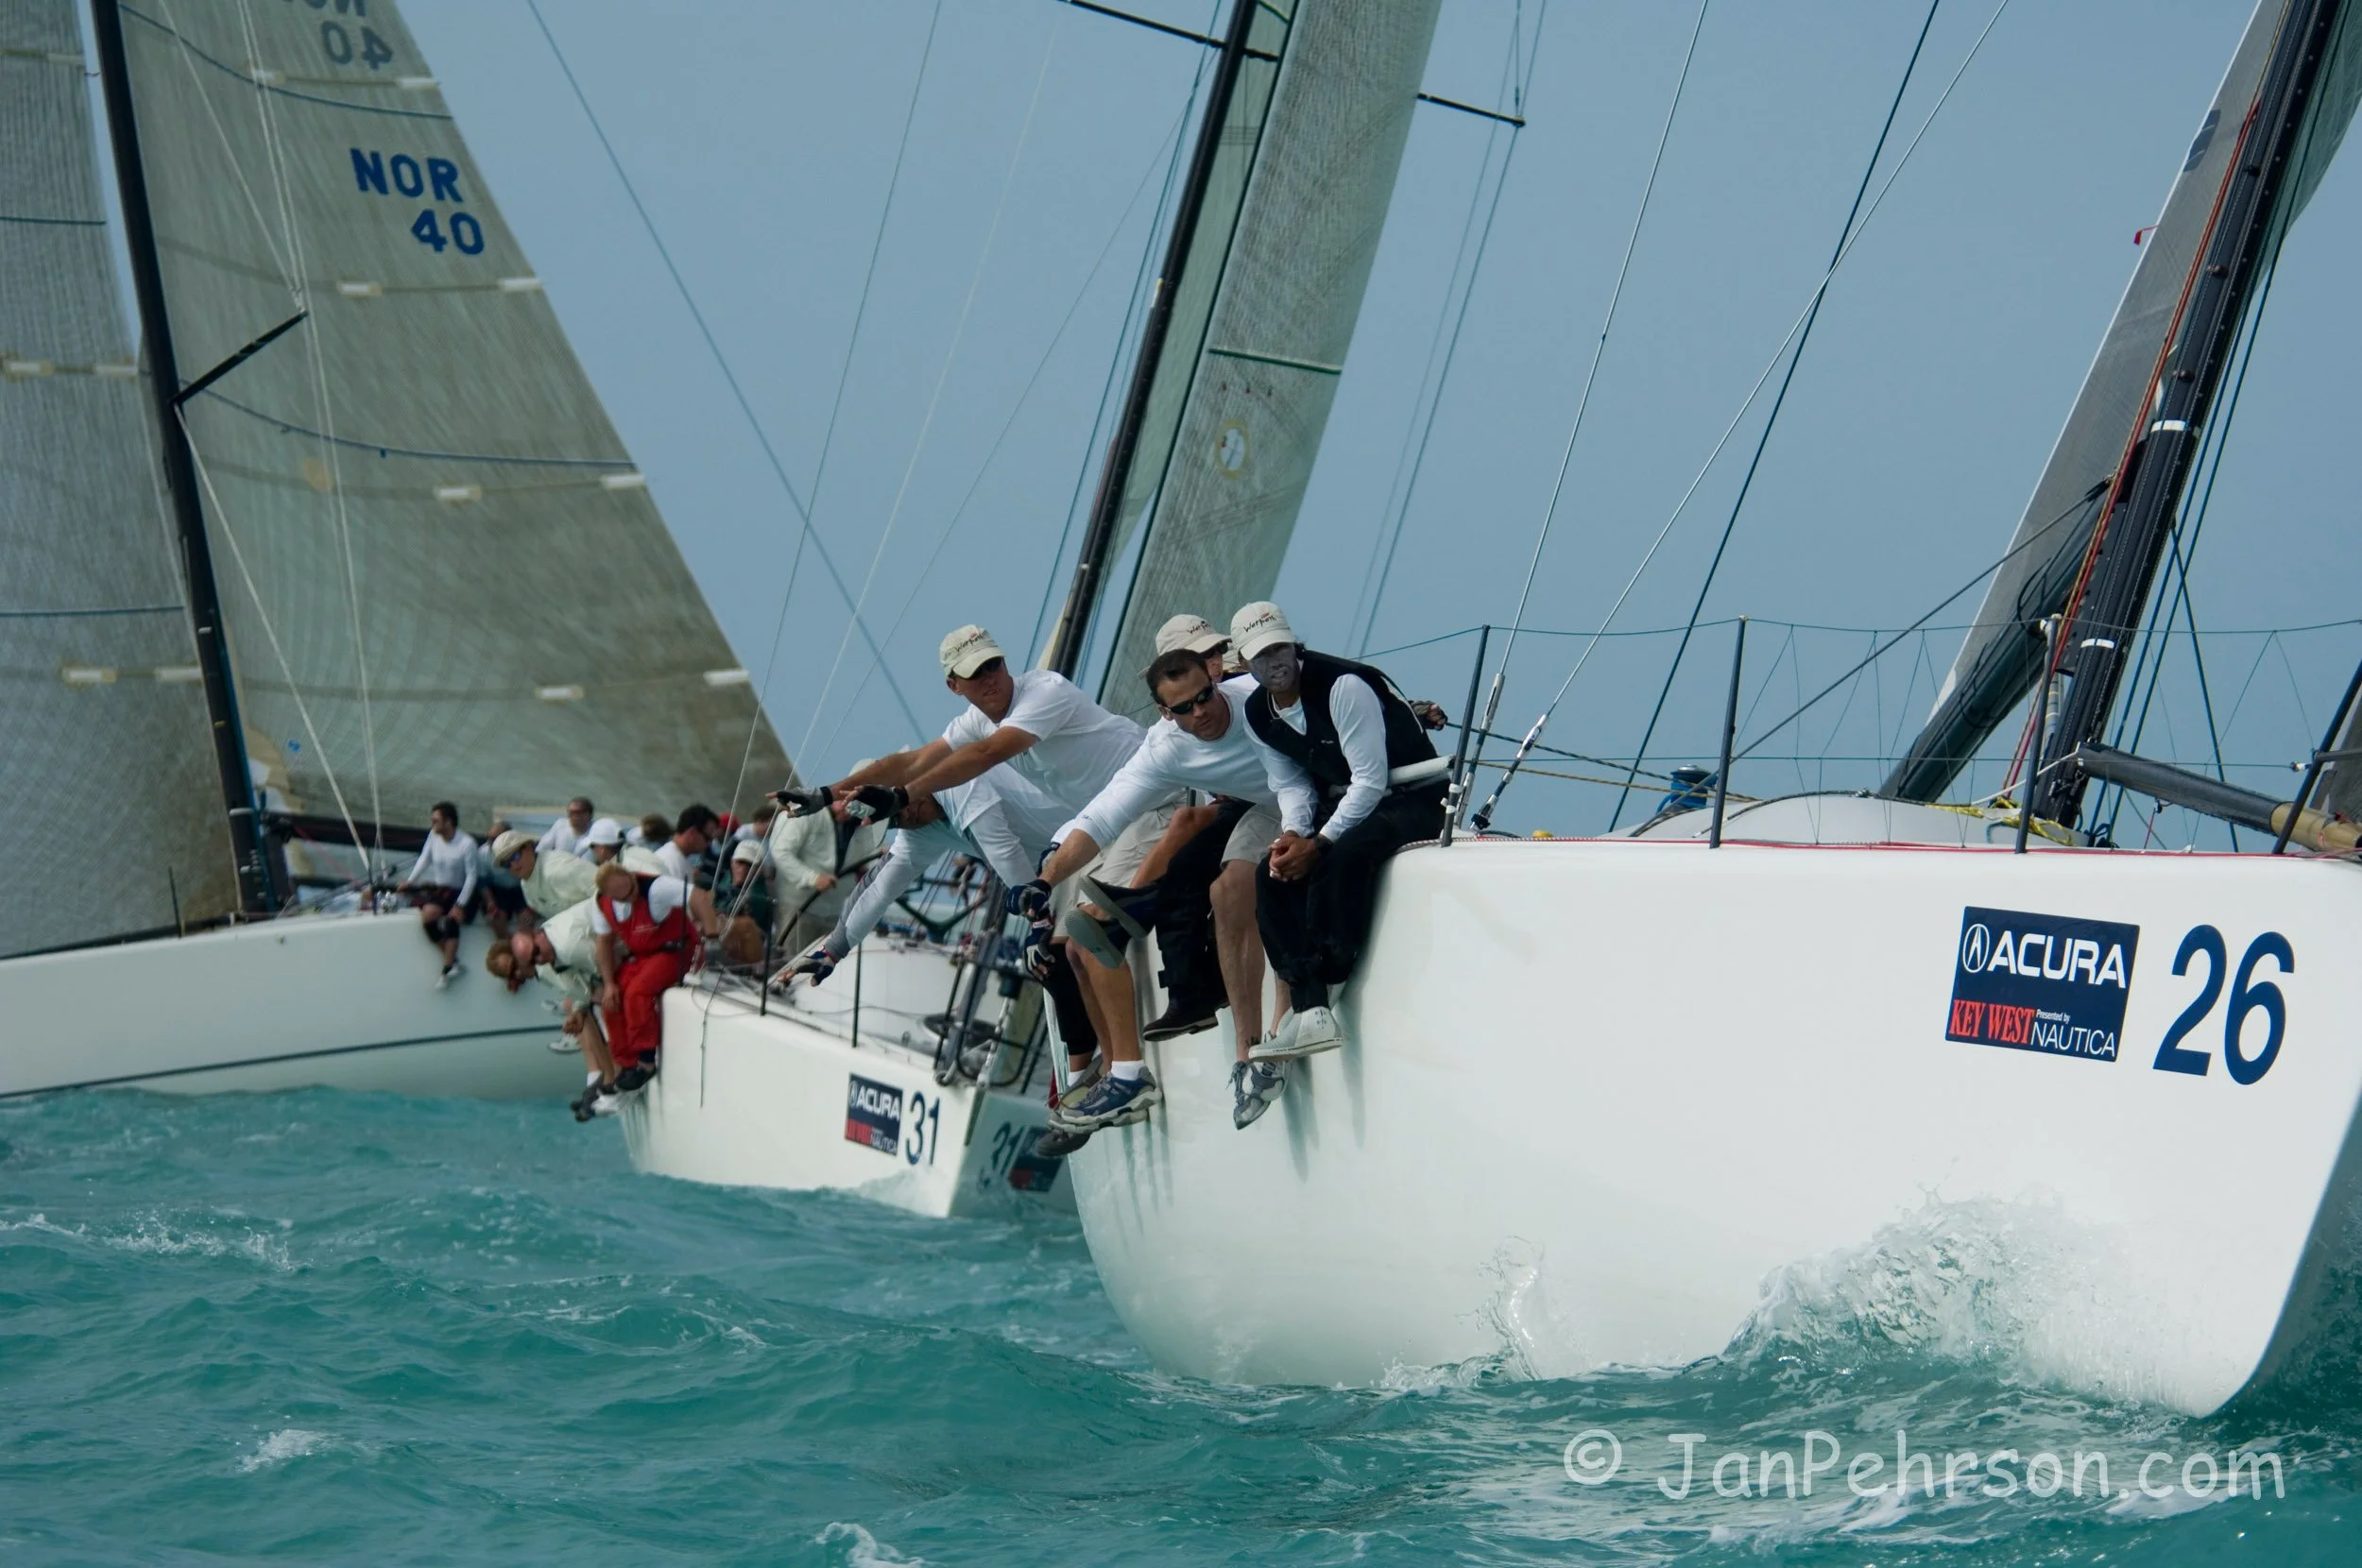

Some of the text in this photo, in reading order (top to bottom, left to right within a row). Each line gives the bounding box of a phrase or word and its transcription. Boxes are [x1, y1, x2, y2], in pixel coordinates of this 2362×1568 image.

[350, 147, 464, 203] NOR
[410, 209, 485, 256] 40
[1986, 930, 2126, 989] ACURA
[1949, 999, 2036, 1045] KEY WEST
[2035, 1009, 2071, 1025] Presented by
[2152, 924, 2296, 1086] 26
[2030, 1021, 2116, 1057] NAUTICA
[855, 1084, 901, 1123] ACURA
[905, 1091, 941, 1167] 31
